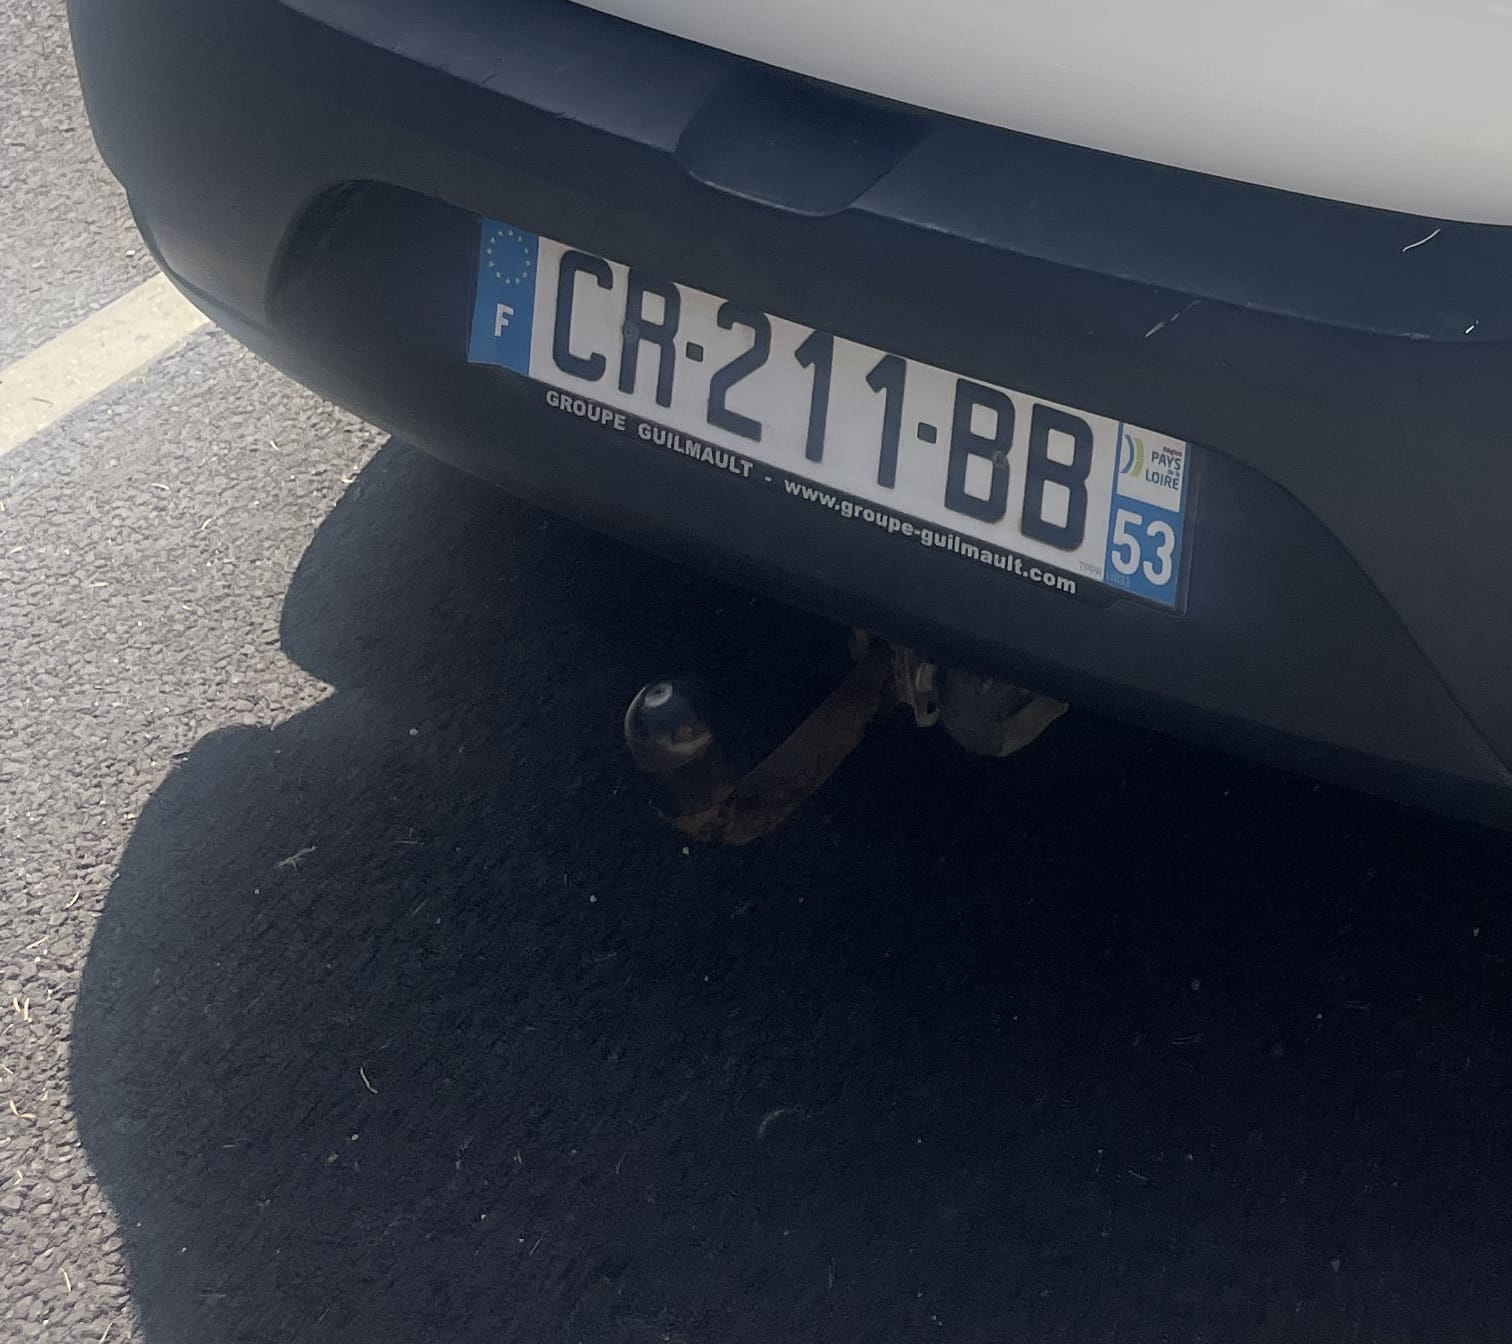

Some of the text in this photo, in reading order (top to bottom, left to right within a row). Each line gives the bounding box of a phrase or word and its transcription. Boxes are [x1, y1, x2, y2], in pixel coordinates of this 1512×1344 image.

[492, 302, 514, 338] F
[552, 249, 1094, 552] CR-211-BB
[1145, 468, 1179, 490] LOIRE
[1151, 450, 1181, 470] PAYS
[546, 390, 626, 431] GROUPE
[637, 423, 753, 478] GUILMAULT
[784, 479, 1076, 594] www.groupe-guilmault.com
[1111, 508, 1176, 586] 53
